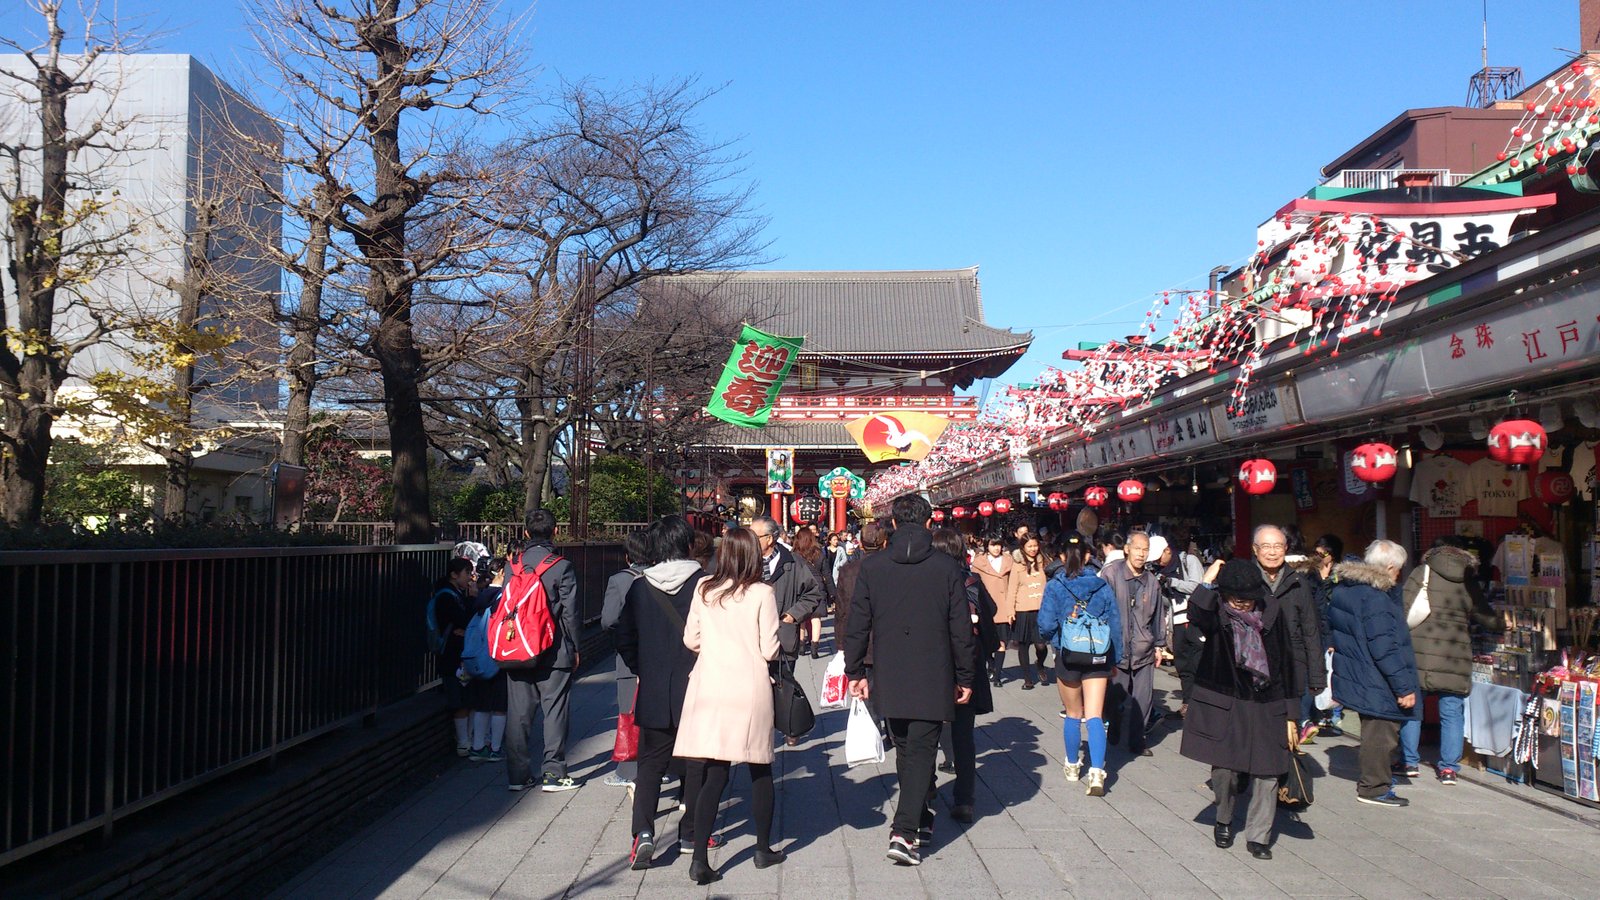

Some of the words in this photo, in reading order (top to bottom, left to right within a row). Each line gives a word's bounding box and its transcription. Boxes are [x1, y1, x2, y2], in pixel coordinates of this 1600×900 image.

[1448, 322, 1495, 360] 念珠
[1520, 313, 1600, 364] 江戸
[721, 339, 790, 417] 迎春
[1481, 489, 1516, 499] TOKYO
